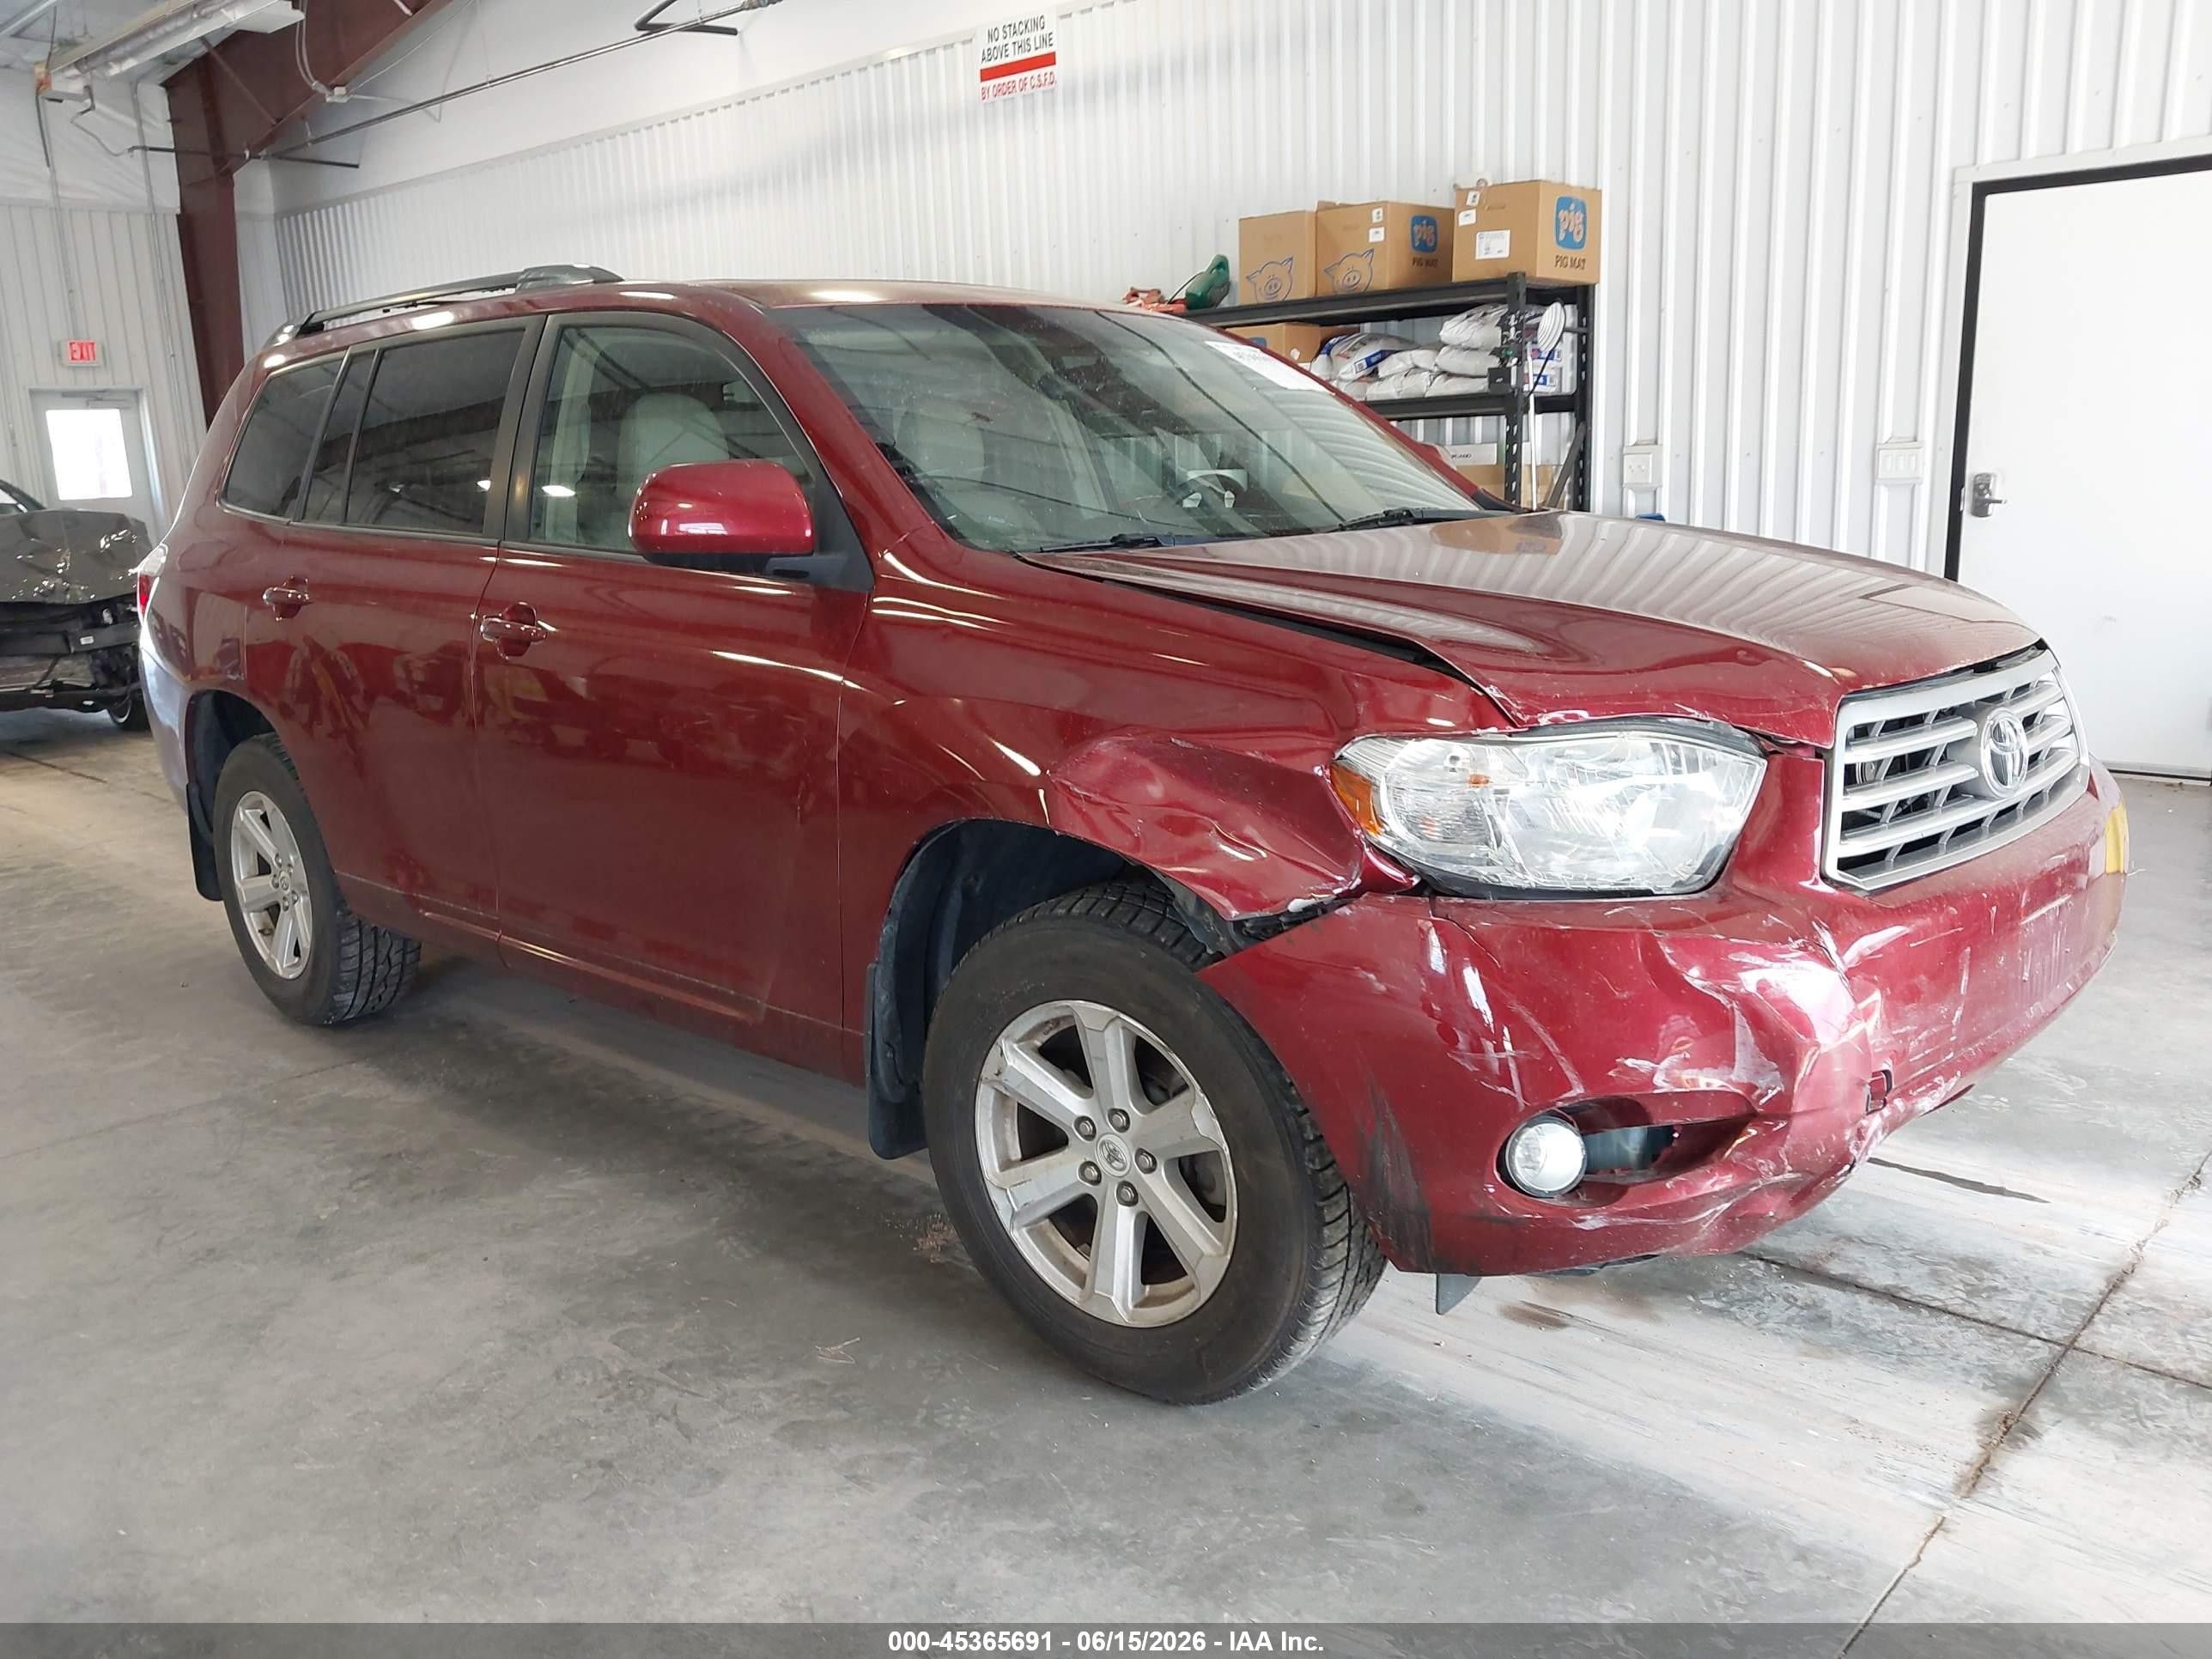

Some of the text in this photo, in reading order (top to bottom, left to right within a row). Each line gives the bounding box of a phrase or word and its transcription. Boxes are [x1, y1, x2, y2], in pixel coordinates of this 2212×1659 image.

[987, 15, 1045, 44] NO STACKING
[981, 31, 1054, 64] ABOVE THIS LINE
[981, 85, 990, 100] BY
[992, 79, 1017, 98] ORDER
[1018, 76, 1028, 93] OF
[1559, 201, 1584, 243] pig
[1554, 254, 1586, 270] PIG MAT
[70, 342, 95, 361] EXIT
